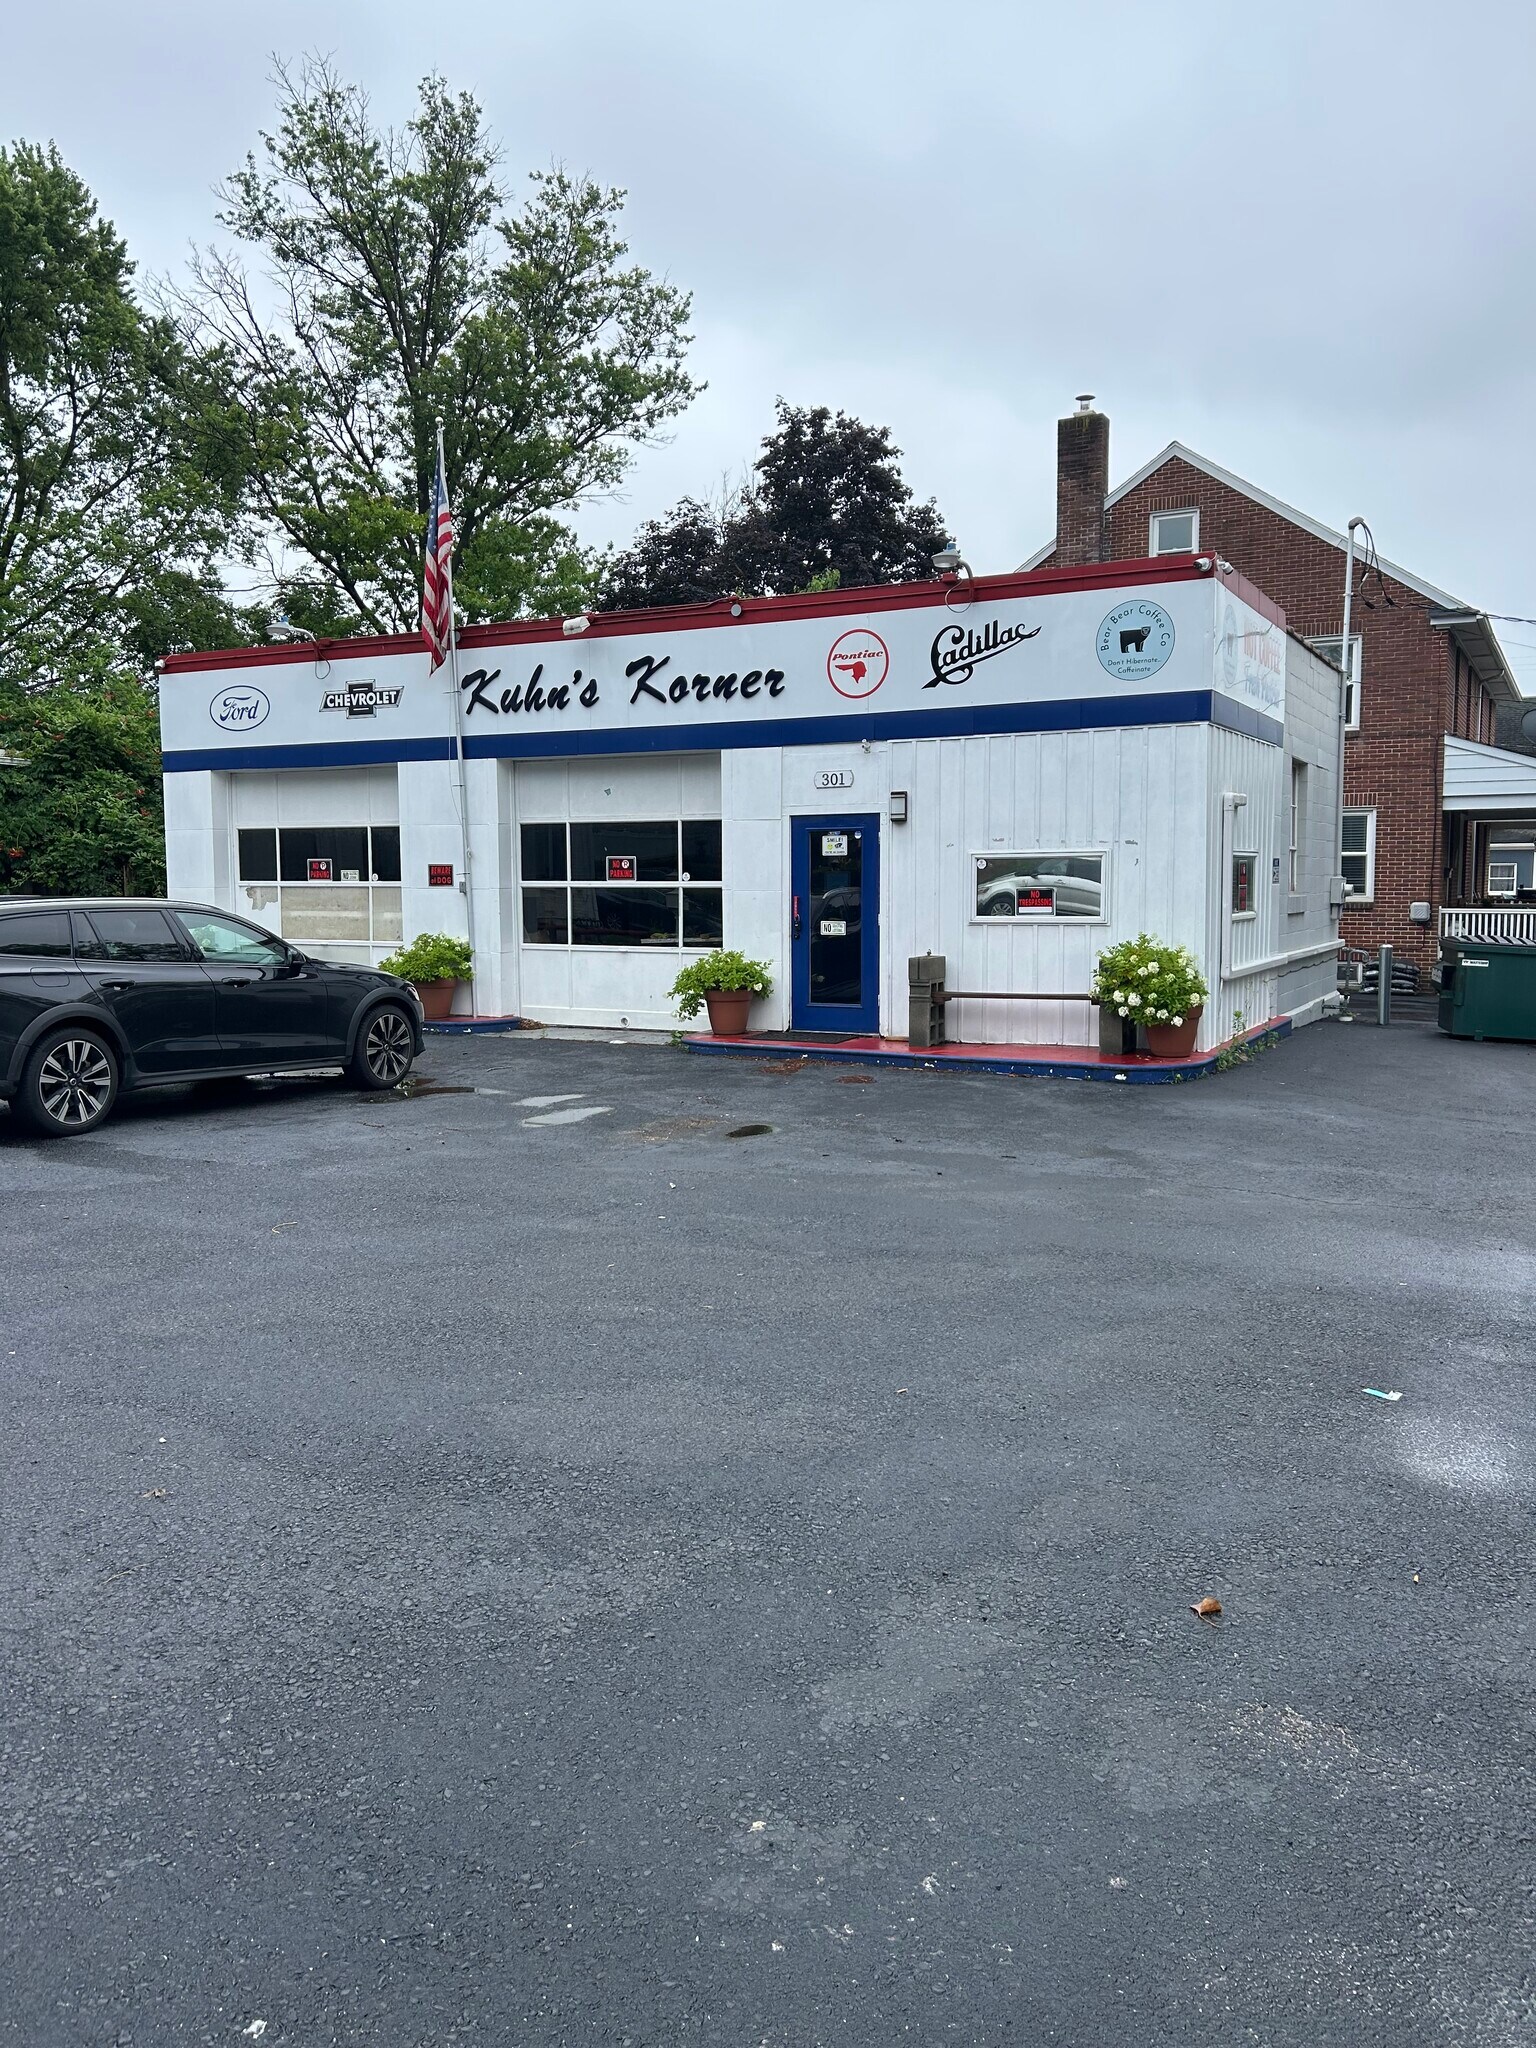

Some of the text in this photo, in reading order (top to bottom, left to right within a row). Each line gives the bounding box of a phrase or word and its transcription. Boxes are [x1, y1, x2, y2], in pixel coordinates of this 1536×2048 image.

[1100, 604, 1170, 651] Bear Bear Coffee Co
[831, 649, 884, 661] Pontiac
[921, 620, 1042, 689] Cadillac
[1117, 666, 1151, 674] Caffeinate
[461, 655, 786, 715] Kuhn's Korner
[326, 691, 397, 708] CHEVROLET
[219, 695, 260, 722] Ford
[821, 772, 845, 787] 301
[612, 860, 620, 869] NO
[310, 870, 330, 879] PARKING
[430, 866, 452, 875] BEWARE
[610, 869, 632, 878] PARKING
[1030, 890, 1040, 899] NO
[1018, 898, 1052, 906] TRESPASSING
[823, 923, 832, 933] NO
